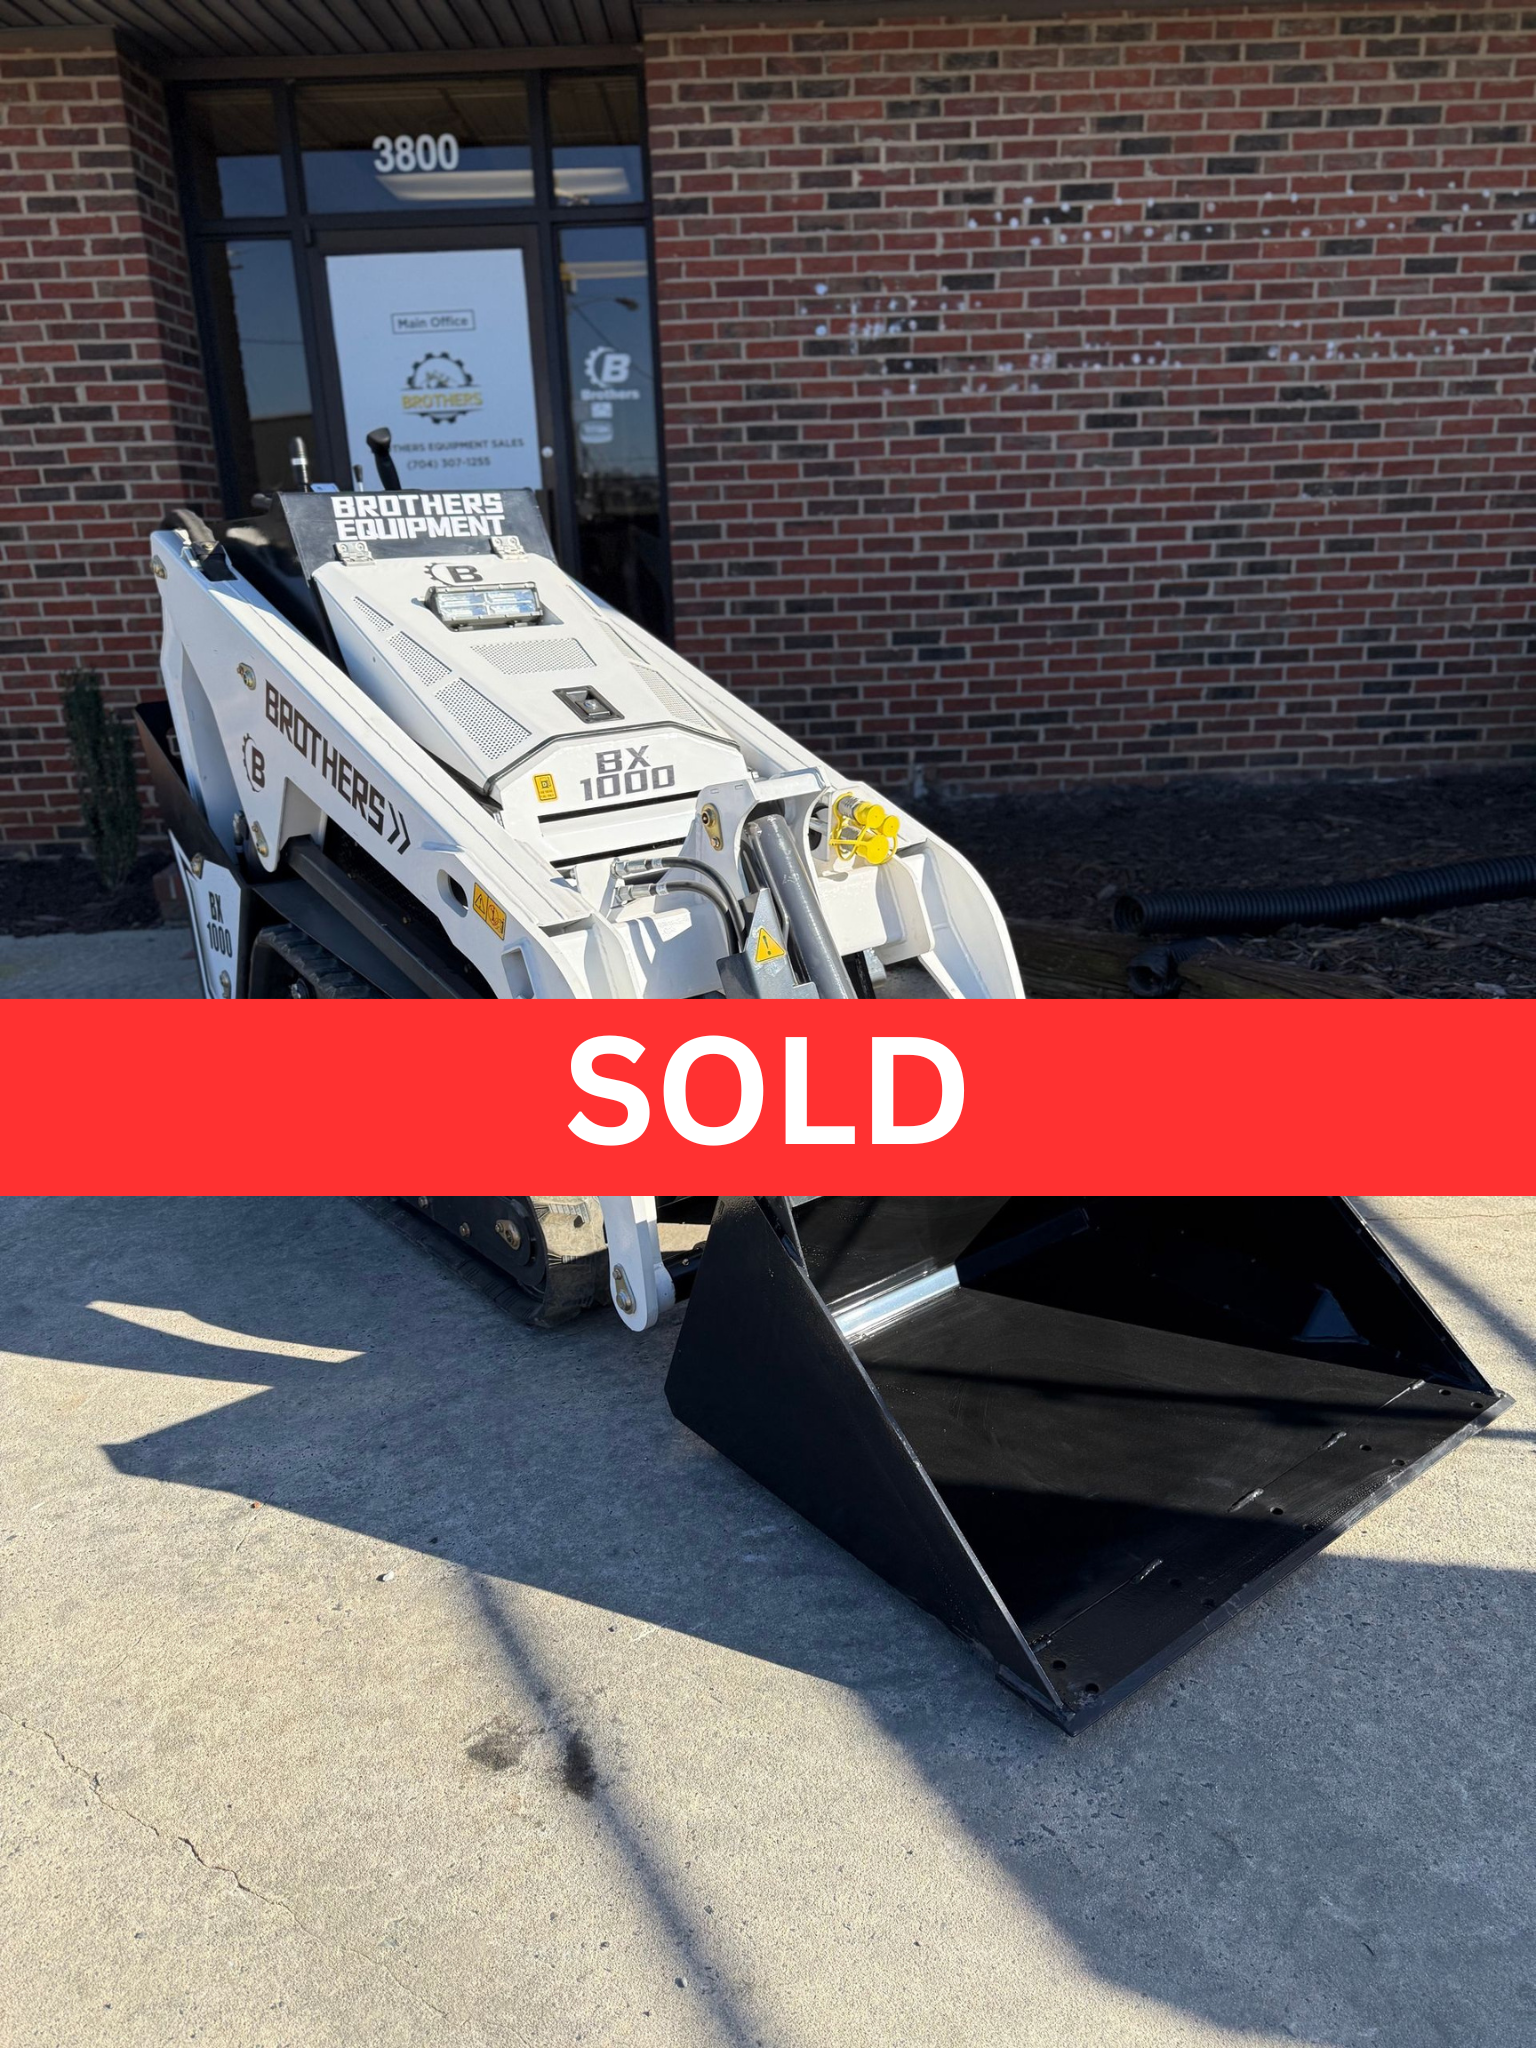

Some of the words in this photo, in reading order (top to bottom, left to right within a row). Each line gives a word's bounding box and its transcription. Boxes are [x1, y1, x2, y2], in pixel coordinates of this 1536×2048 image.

[373, 133, 459, 173] 3800
[398, 318, 427, 329] Main
[431, 316, 468, 327] Office
[602, 353, 631, 383] B
[402, 392, 483, 409] BROTHERS
[428, 441, 488, 451] EQUIPMENT
[491, 438, 524, 448] SALES
[407, 459, 438, 470] (704)
[442, 456, 491, 467] 307-1255
[331, 493, 504, 518] BROTHERS
[335, 515, 505, 541] EQUIPMENT
[446, 565, 484, 583] B
[252, 745, 265, 789] B
[265, 679, 386, 836] BROTHERS
[595, 744, 651, 775] BX
[579, 764, 676, 802] 1000
[208, 891, 224, 925] BX
[206, 921, 233, 958] 1000
